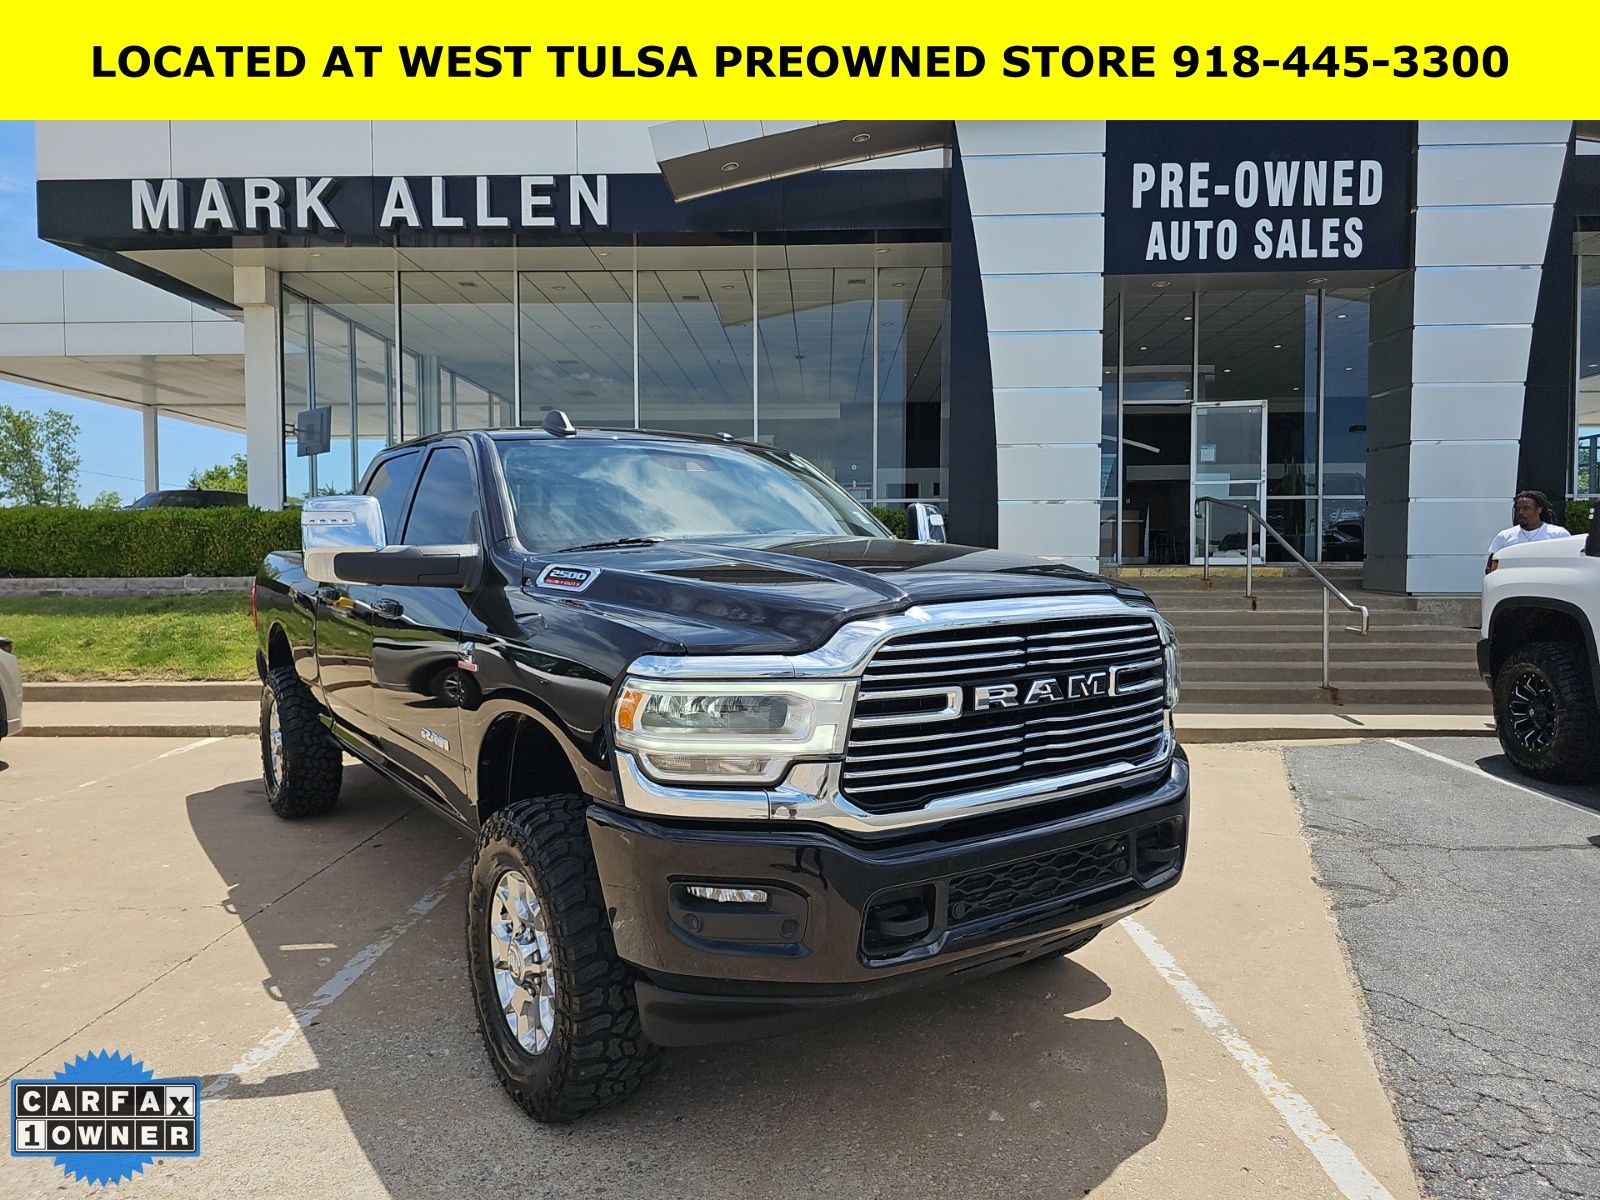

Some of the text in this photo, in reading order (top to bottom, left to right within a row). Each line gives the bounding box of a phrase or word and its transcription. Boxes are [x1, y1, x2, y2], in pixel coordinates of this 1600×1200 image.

[131, 175, 609, 231] MARK ALLEN
[1132, 160, 1382, 208] PRE-OWNED
[1146, 216, 1363, 261] AUTO SALES
[550, 569, 587, 580] 2500
[974, 672, 1106, 711] RAM
